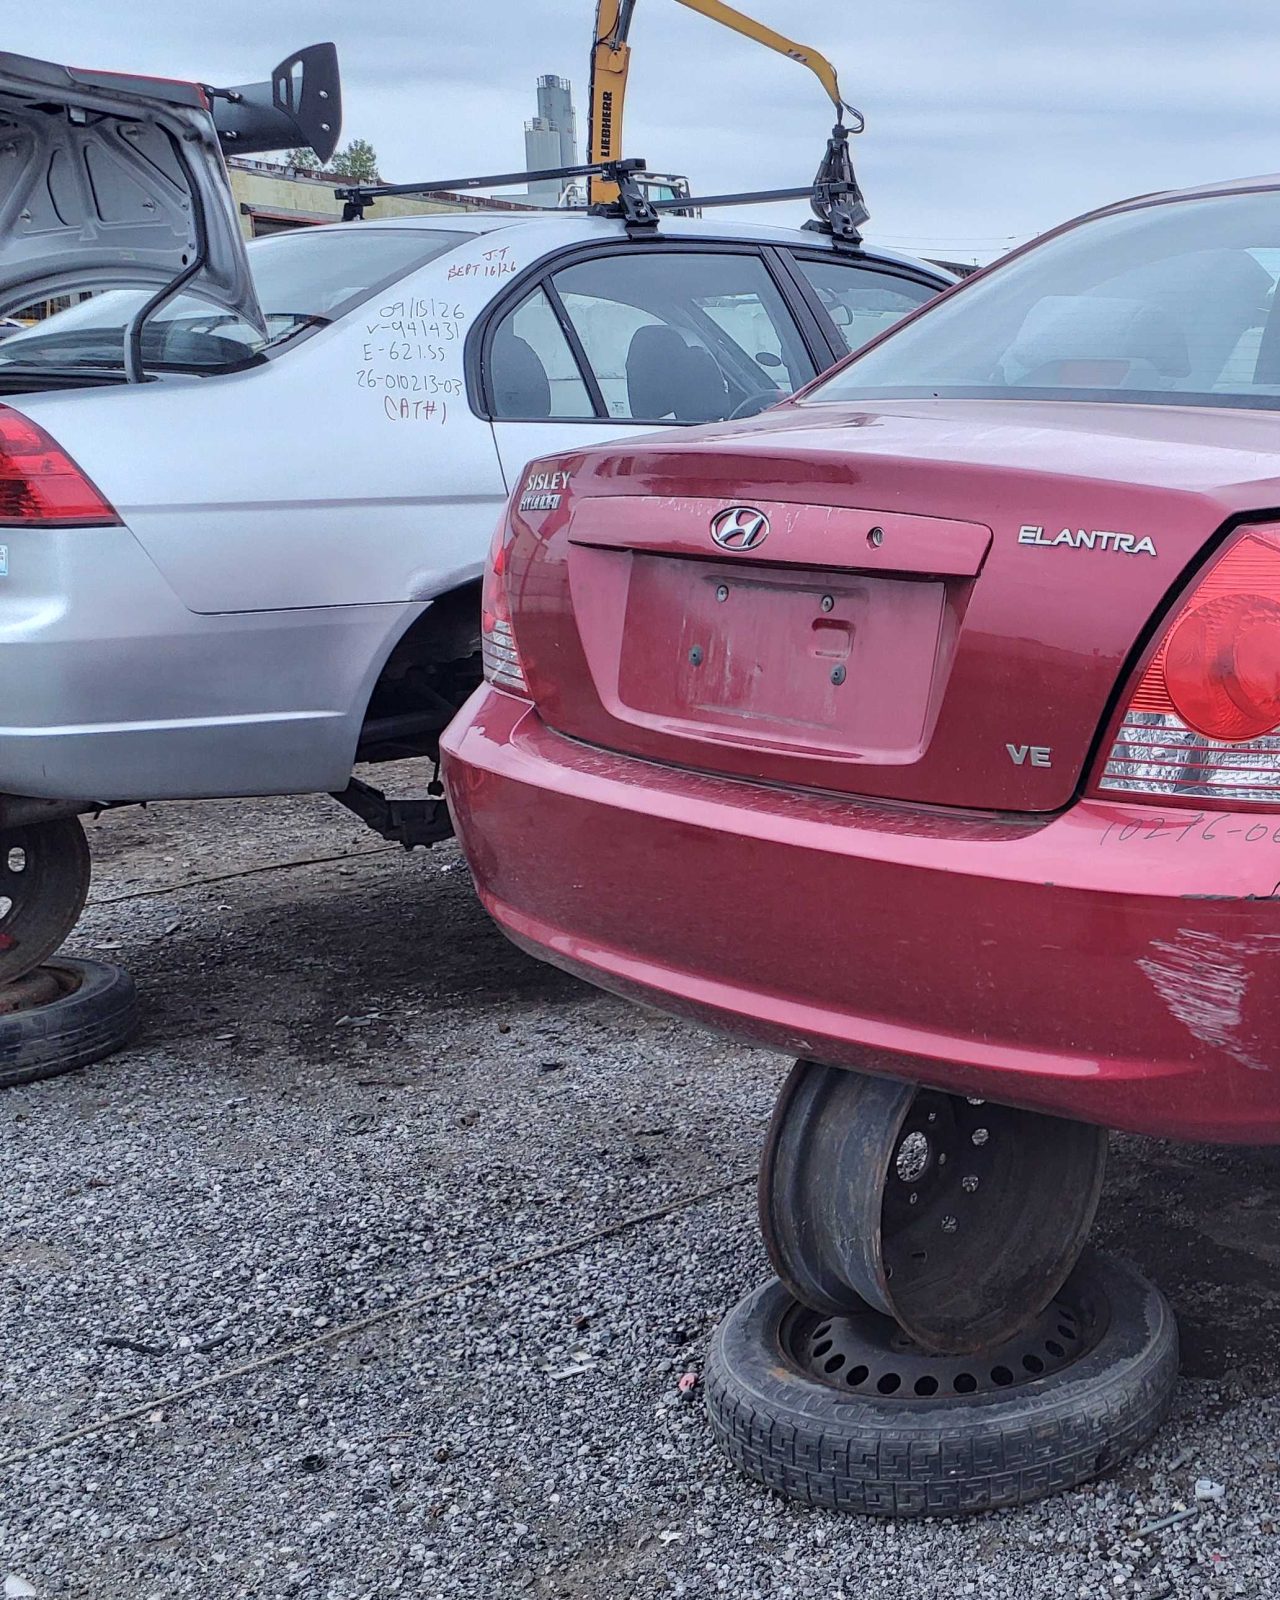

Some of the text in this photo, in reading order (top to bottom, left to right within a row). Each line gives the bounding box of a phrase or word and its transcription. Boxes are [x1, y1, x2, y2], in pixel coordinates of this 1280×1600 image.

[599, 91, 613, 158] LIEBHERR
[379, 297, 465, 320] 09/15/26
[526, 471, 572, 491] SISLEY
[1018, 524, 1157, 557] ELANTRA
[1005, 743, 1052, 767] VE
